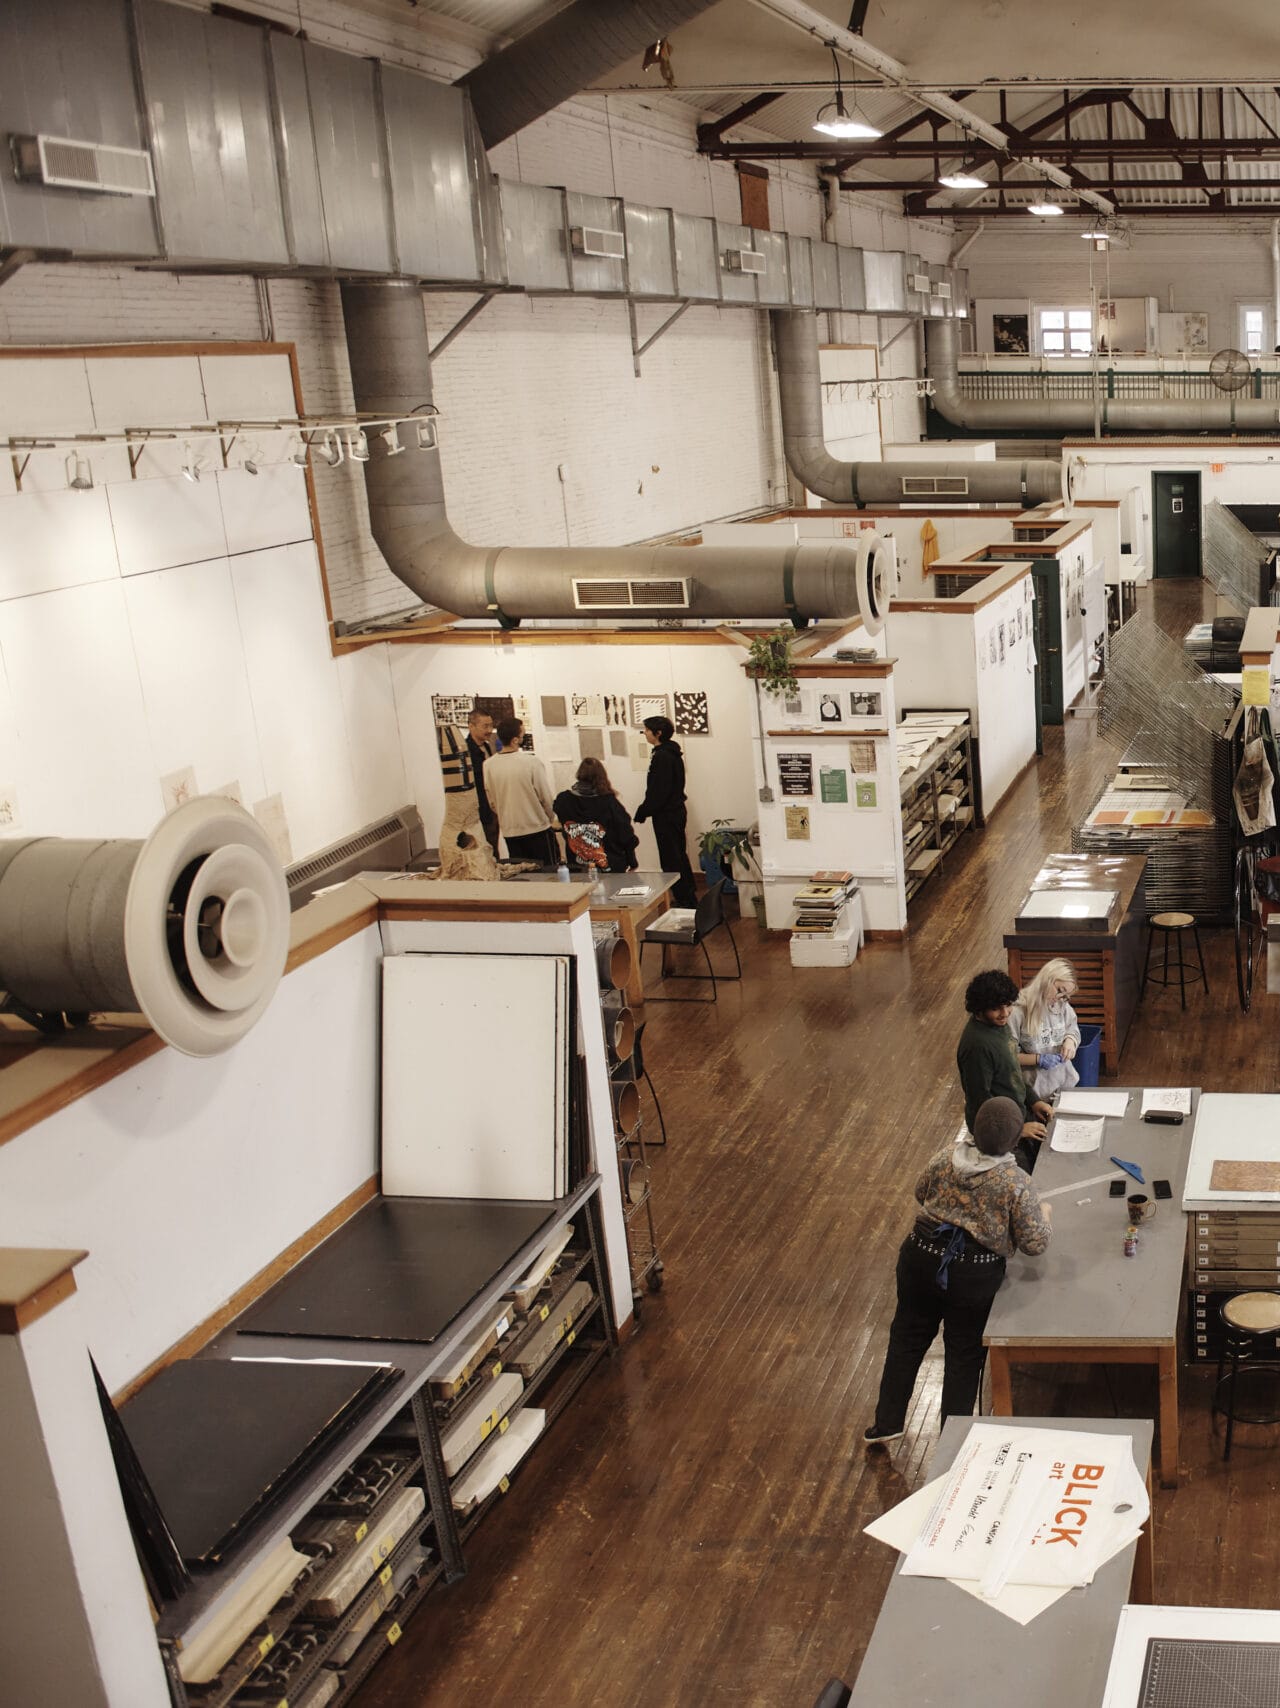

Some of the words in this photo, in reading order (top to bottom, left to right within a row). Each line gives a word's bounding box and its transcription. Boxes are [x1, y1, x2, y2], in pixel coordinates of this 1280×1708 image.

[485, 1414, 493, 1428] 7
[1049, 1462, 1066, 1480] art
[1045, 1463, 1105, 1548] BLICK
